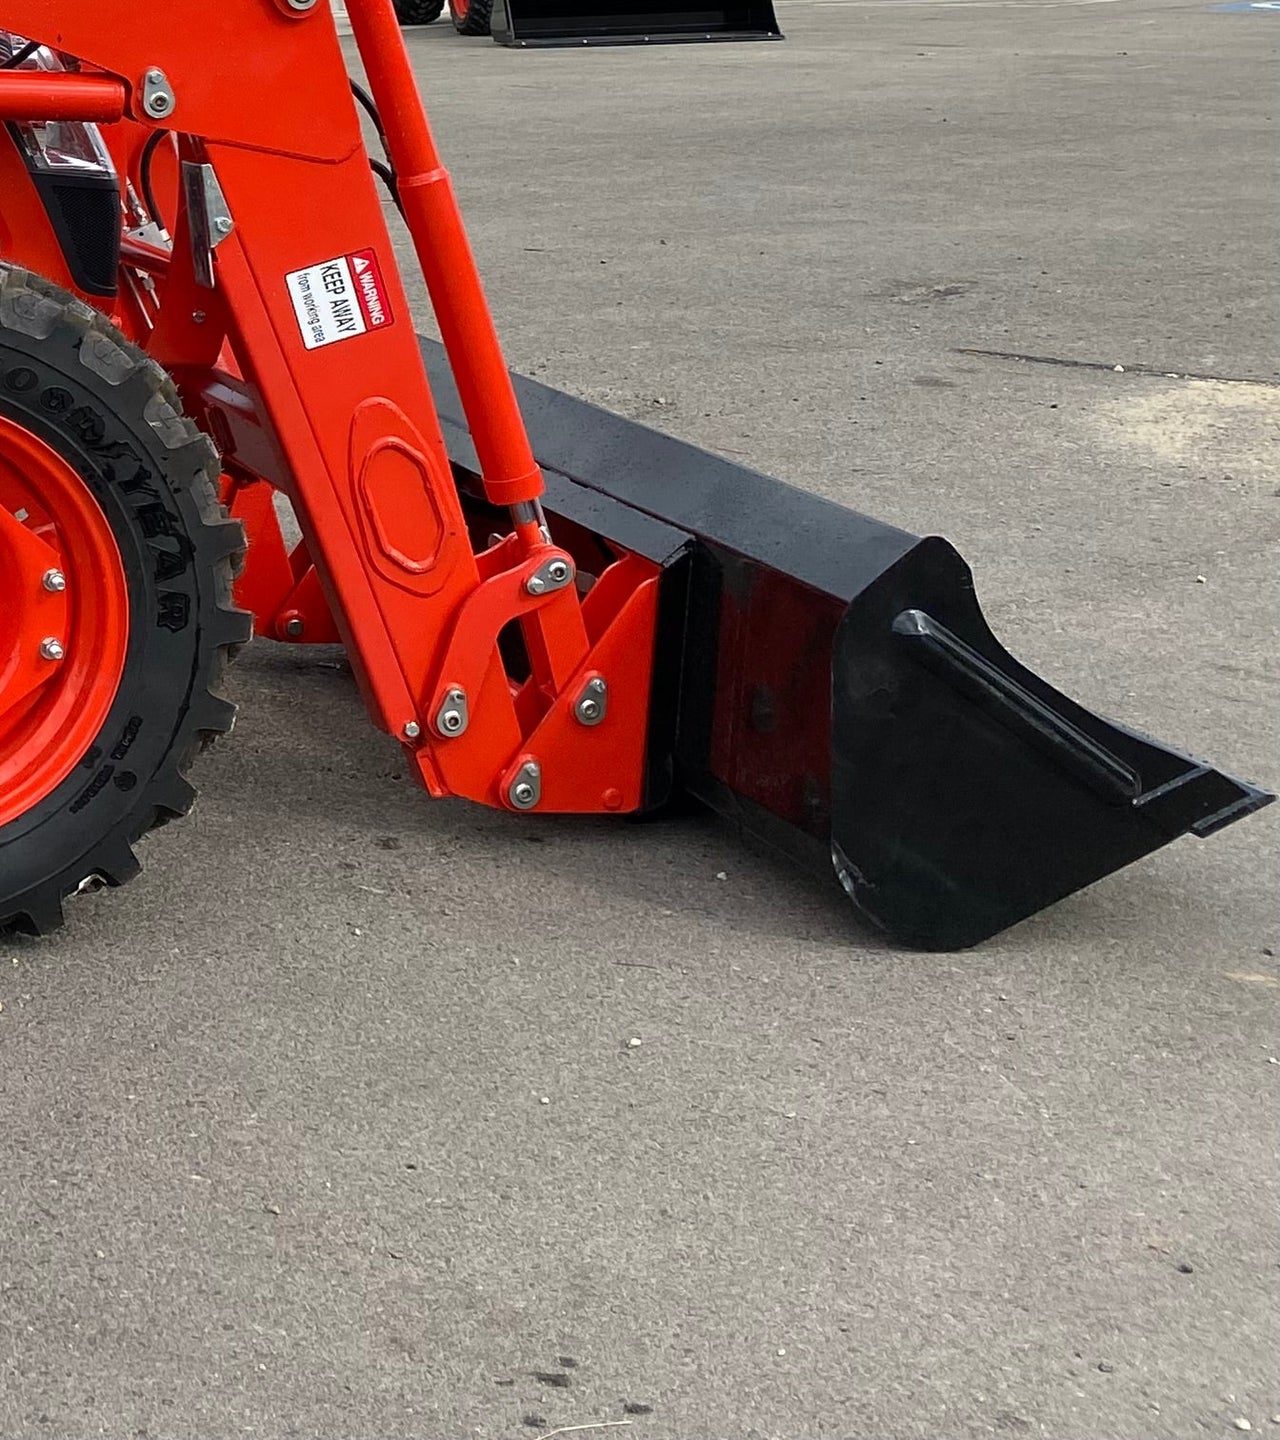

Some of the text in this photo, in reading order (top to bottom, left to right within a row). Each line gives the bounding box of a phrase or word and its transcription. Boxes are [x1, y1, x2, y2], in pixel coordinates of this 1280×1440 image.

[297, 272, 326, 343] from working area
[320, 263, 357, 333] KEEP AWAY
[358, 271, 385, 325] WARNING
